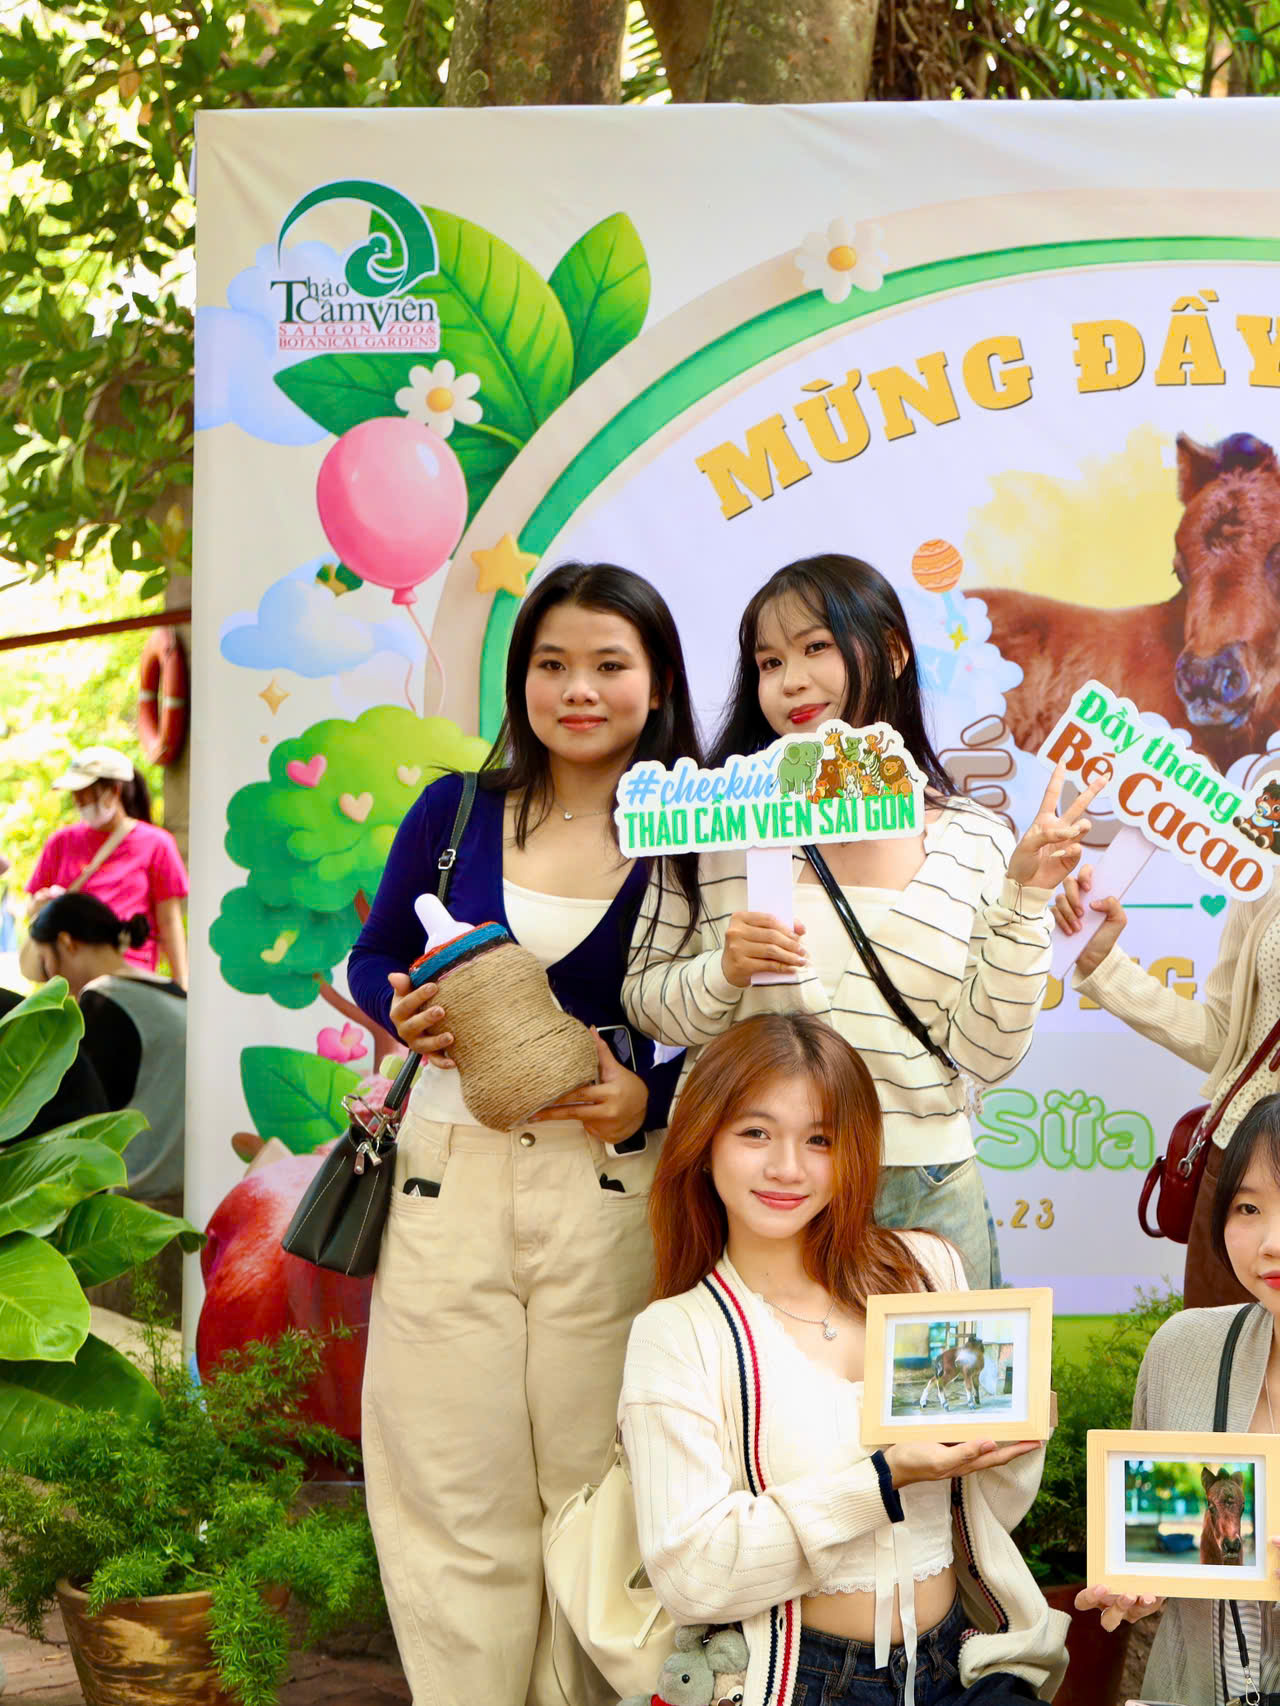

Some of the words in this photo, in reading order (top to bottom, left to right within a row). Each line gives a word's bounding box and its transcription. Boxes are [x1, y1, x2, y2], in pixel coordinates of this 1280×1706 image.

[279, 324, 371, 336] SAIGON
[279, 336, 359, 348] BOTANICAL
[364, 336, 438, 348] GARDENS
[694, 335, 1035, 521] MỪNG
[1074, 689, 1145, 755] Đầy
[1141, 735, 1243, 825] tháng
[624, 800, 689, 849] THẢO
[694, 792, 747, 845] CẦM
[751, 793, 813, 839] VIÊN
[818, 787, 858, 836] SÀI
[863, 785, 916, 832] GÒN
[1046, 720, 1117, 787] Bé
[1117, 772, 1264, 893] Cacao
[974, 1088, 1155, 1171] Sữa
